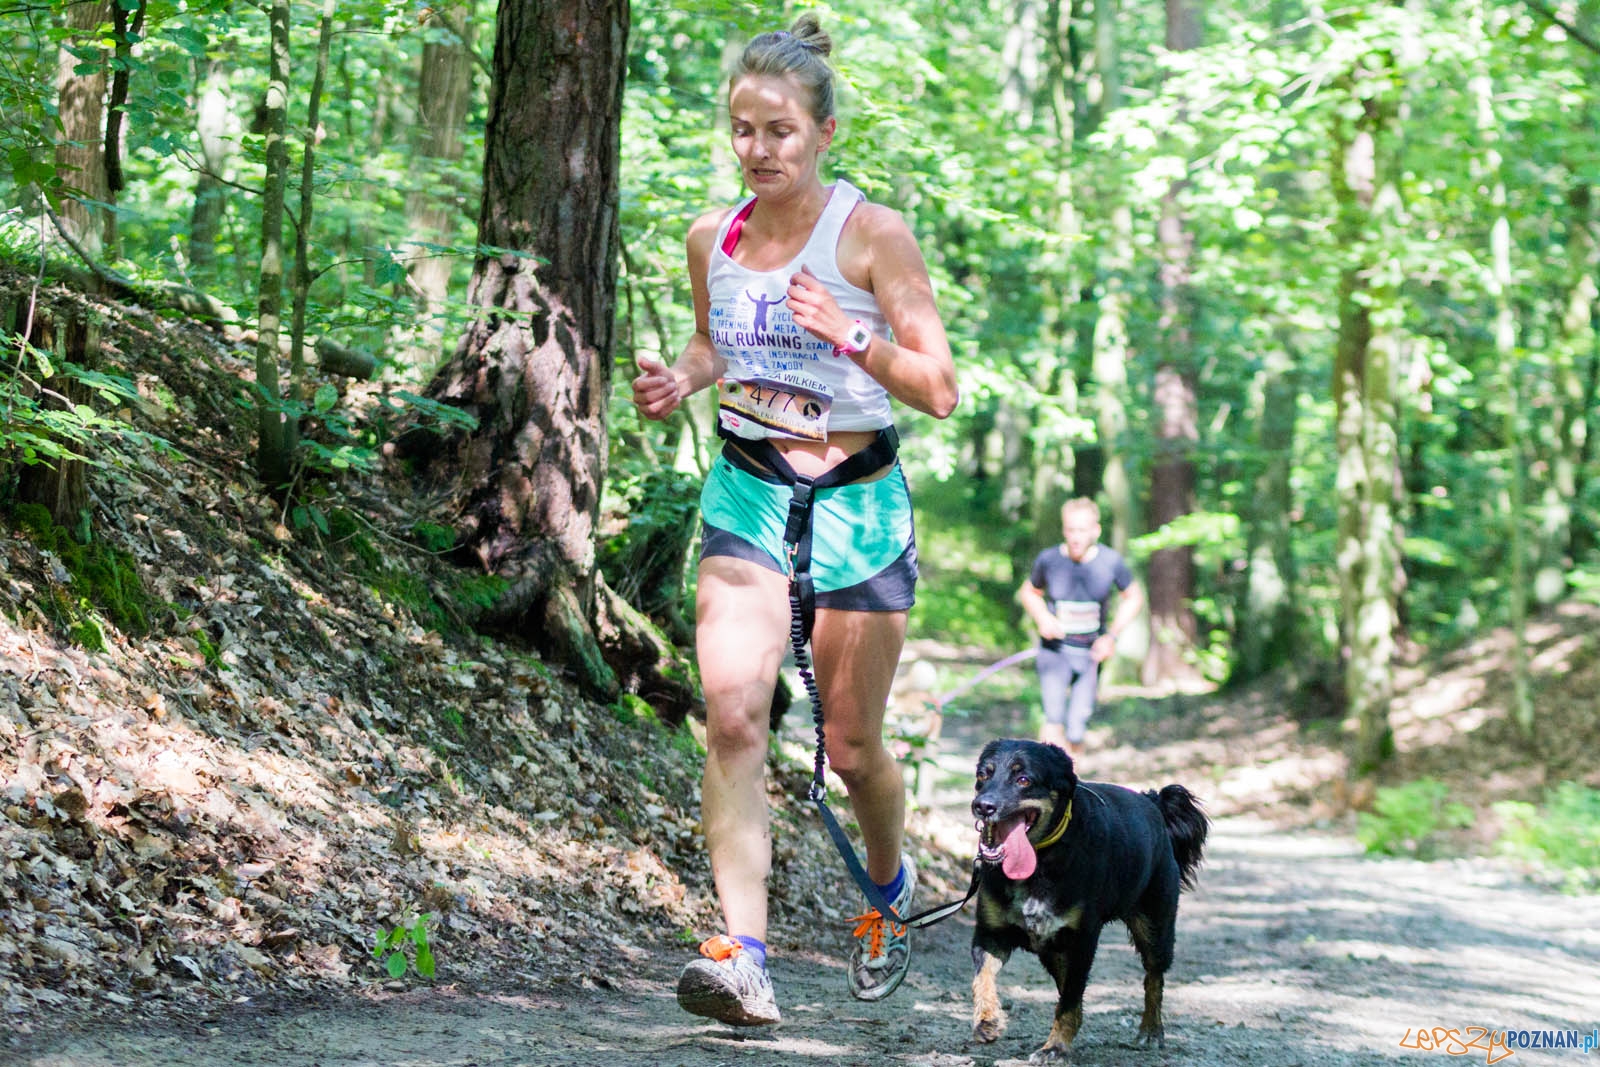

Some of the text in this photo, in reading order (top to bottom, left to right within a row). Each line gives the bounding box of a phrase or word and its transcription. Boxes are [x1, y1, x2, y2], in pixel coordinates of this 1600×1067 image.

[718, 319, 748, 330] TRENING
[774, 323, 797, 334] META
[736, 331, 802, 350] RUNNING
[772, 360, 804, 371] ZAWODY
[784, 373, 827, 392] WILKIEM
[750, 385, 796, 412] 477
